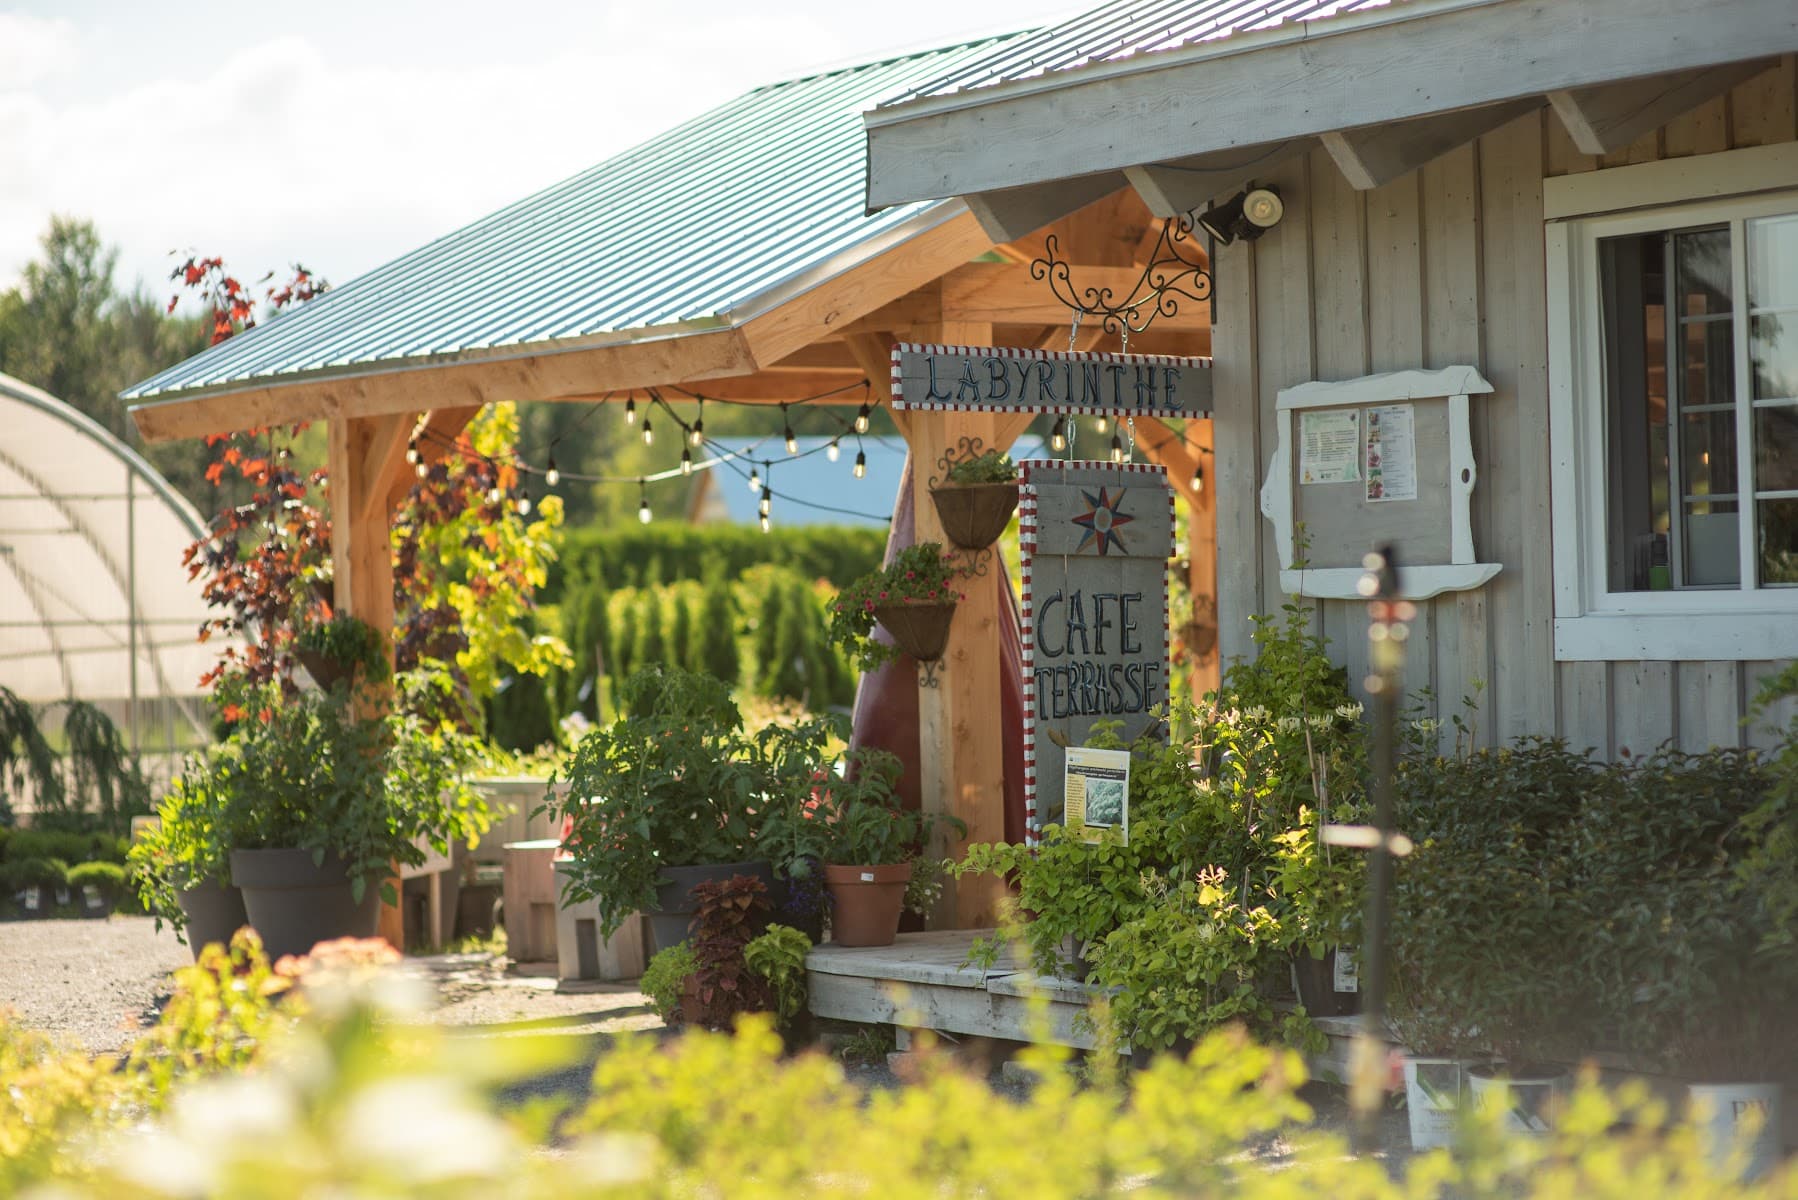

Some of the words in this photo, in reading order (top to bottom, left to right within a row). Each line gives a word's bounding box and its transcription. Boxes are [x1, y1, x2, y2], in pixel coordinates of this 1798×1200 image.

[925, 354, 1185, 410] LABYRINTHE
[1037, 588, 1142, 658] CAFE
[1034, 660, 1160, 721] TERRASSE
